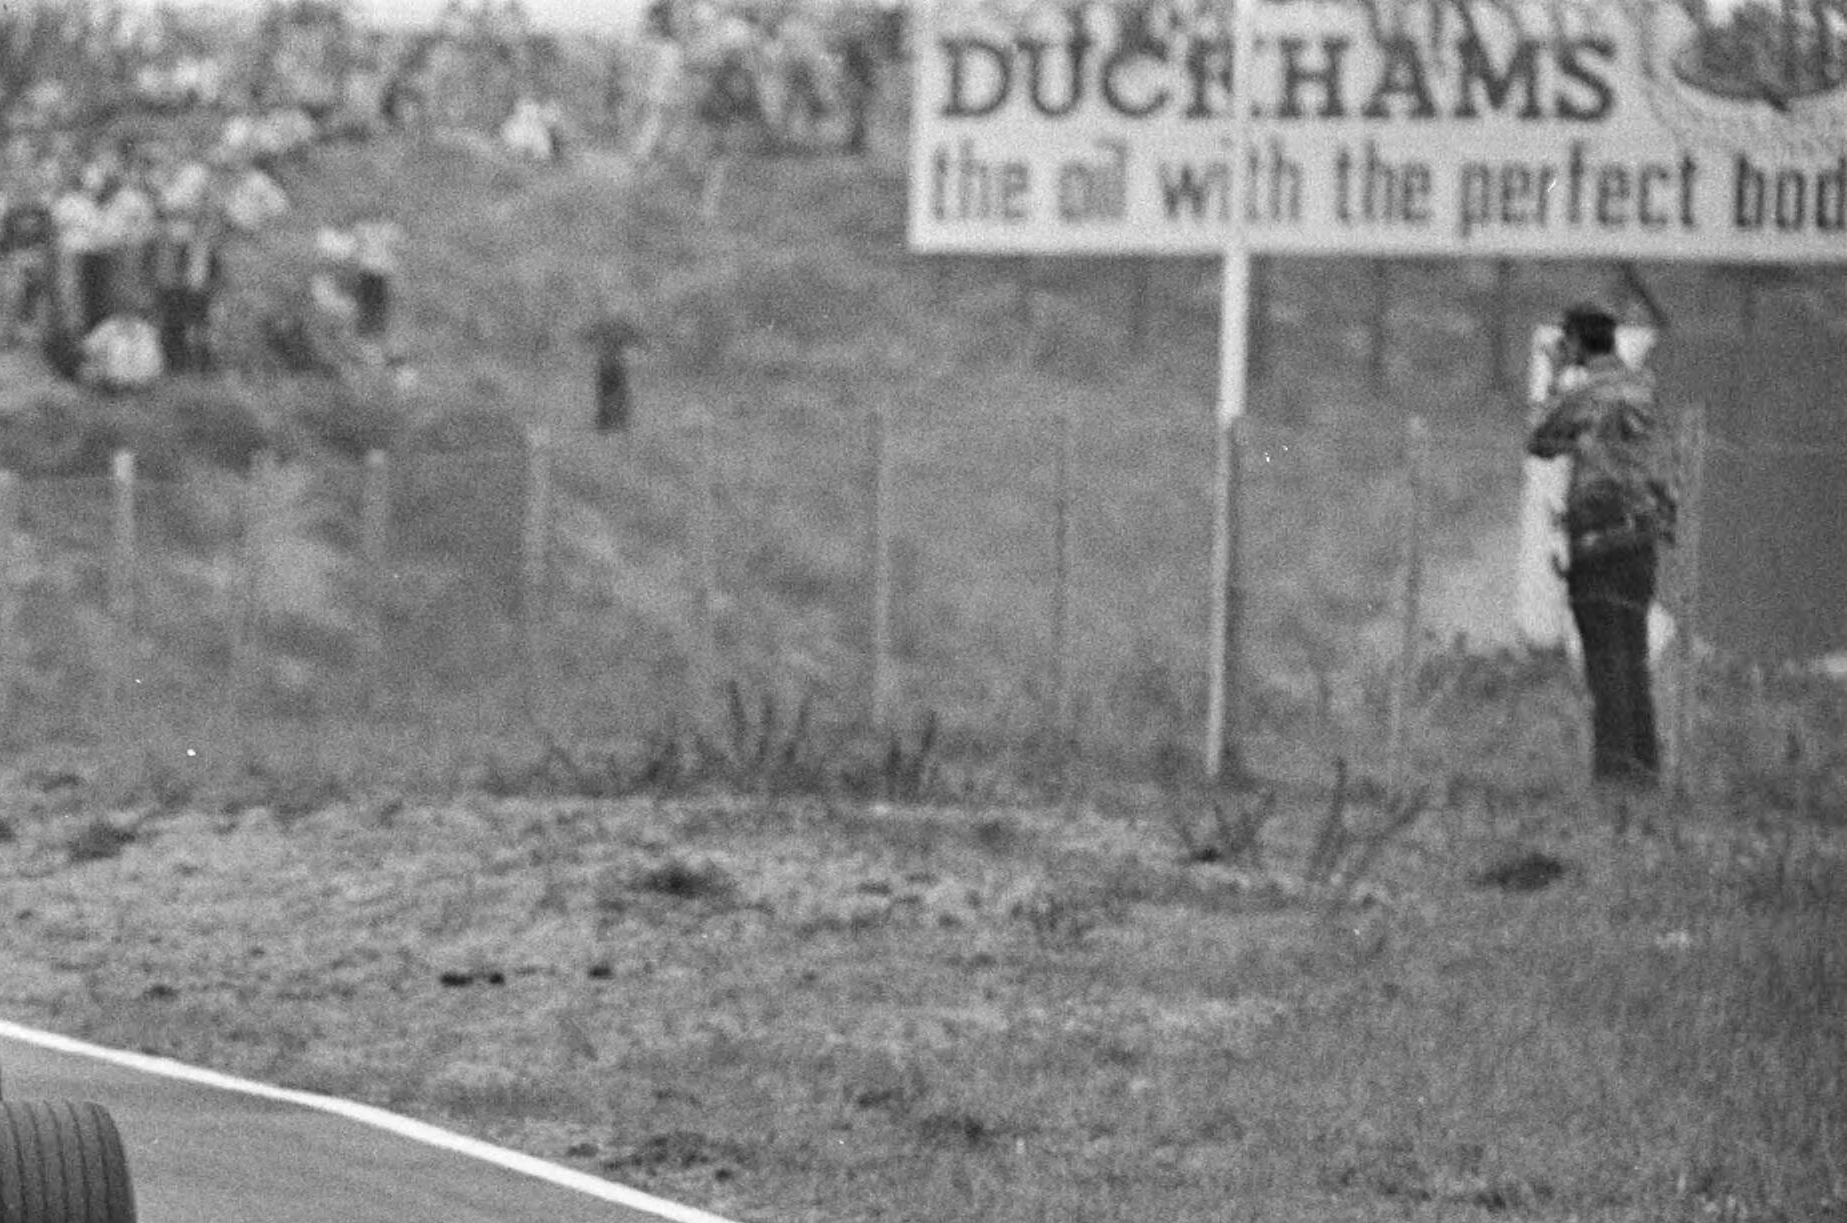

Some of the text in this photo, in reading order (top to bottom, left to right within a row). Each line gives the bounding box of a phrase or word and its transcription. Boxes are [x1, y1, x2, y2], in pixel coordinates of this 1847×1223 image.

[931, 138, 1029, 224] the
[1335, 140, 1433, 226] the
[1460, 140, 1698, 240] perfect
